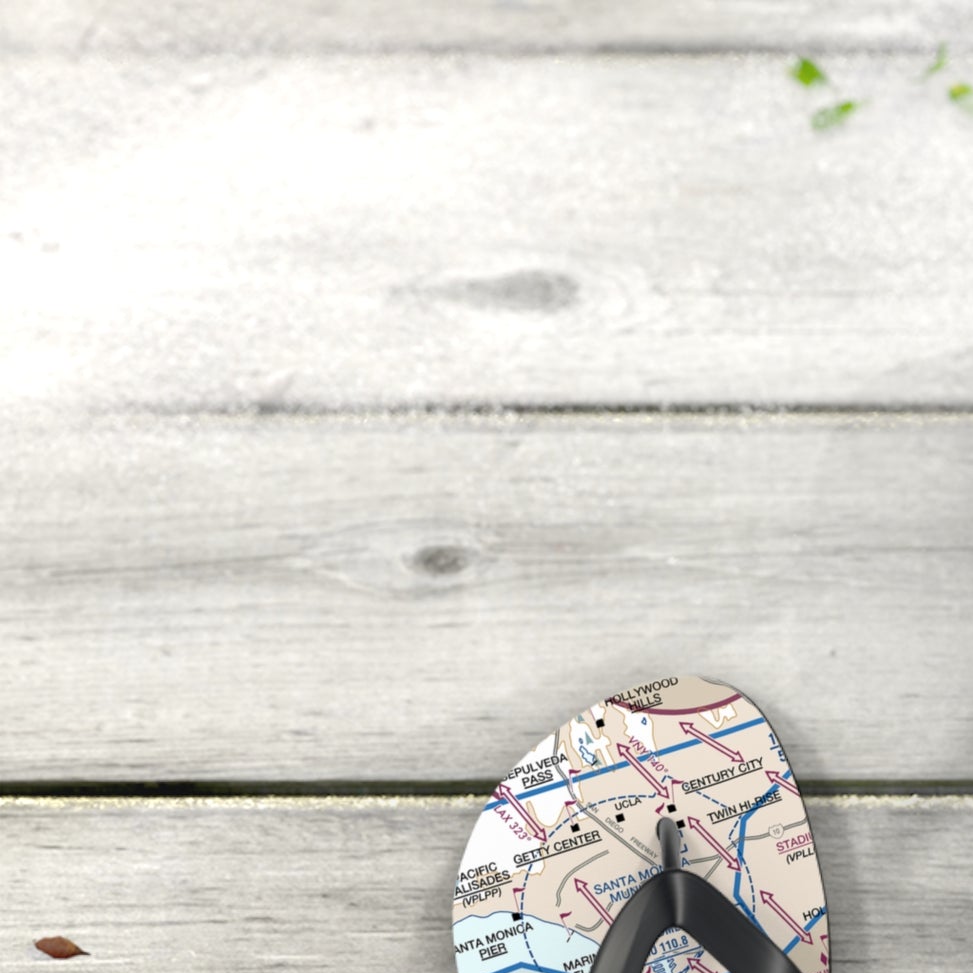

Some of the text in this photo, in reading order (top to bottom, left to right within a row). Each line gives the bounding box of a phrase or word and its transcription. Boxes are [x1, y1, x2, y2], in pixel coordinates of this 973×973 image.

[605, 676, 678, 707] HOLLYWOOD
[629, 693, 662, 711] HILLS
[628, 736, 648, 756] VNY
[522, 770, 553, 787] PASS
[681, 757, 763, 792] CENTURY CITY
[615, 797, 642, 810] UCLA
[707, 790, 781, 821] TWIN HI-RISE
[494, 806, 512, 825] LAX
[605, 817, 624, 833] DIEGO
[513, 830, 601, 865] GETTY CENTER
[630, 837, 658, 858] FREEWAY
[594, 876, 636, 894] SANTA
[463, 887, 501, 908] (VPLPP)
[485, 922, 533, 943] MONICA
[479, 943, 507, 958] PIER
[660, 935, 688, 951] 110.8
